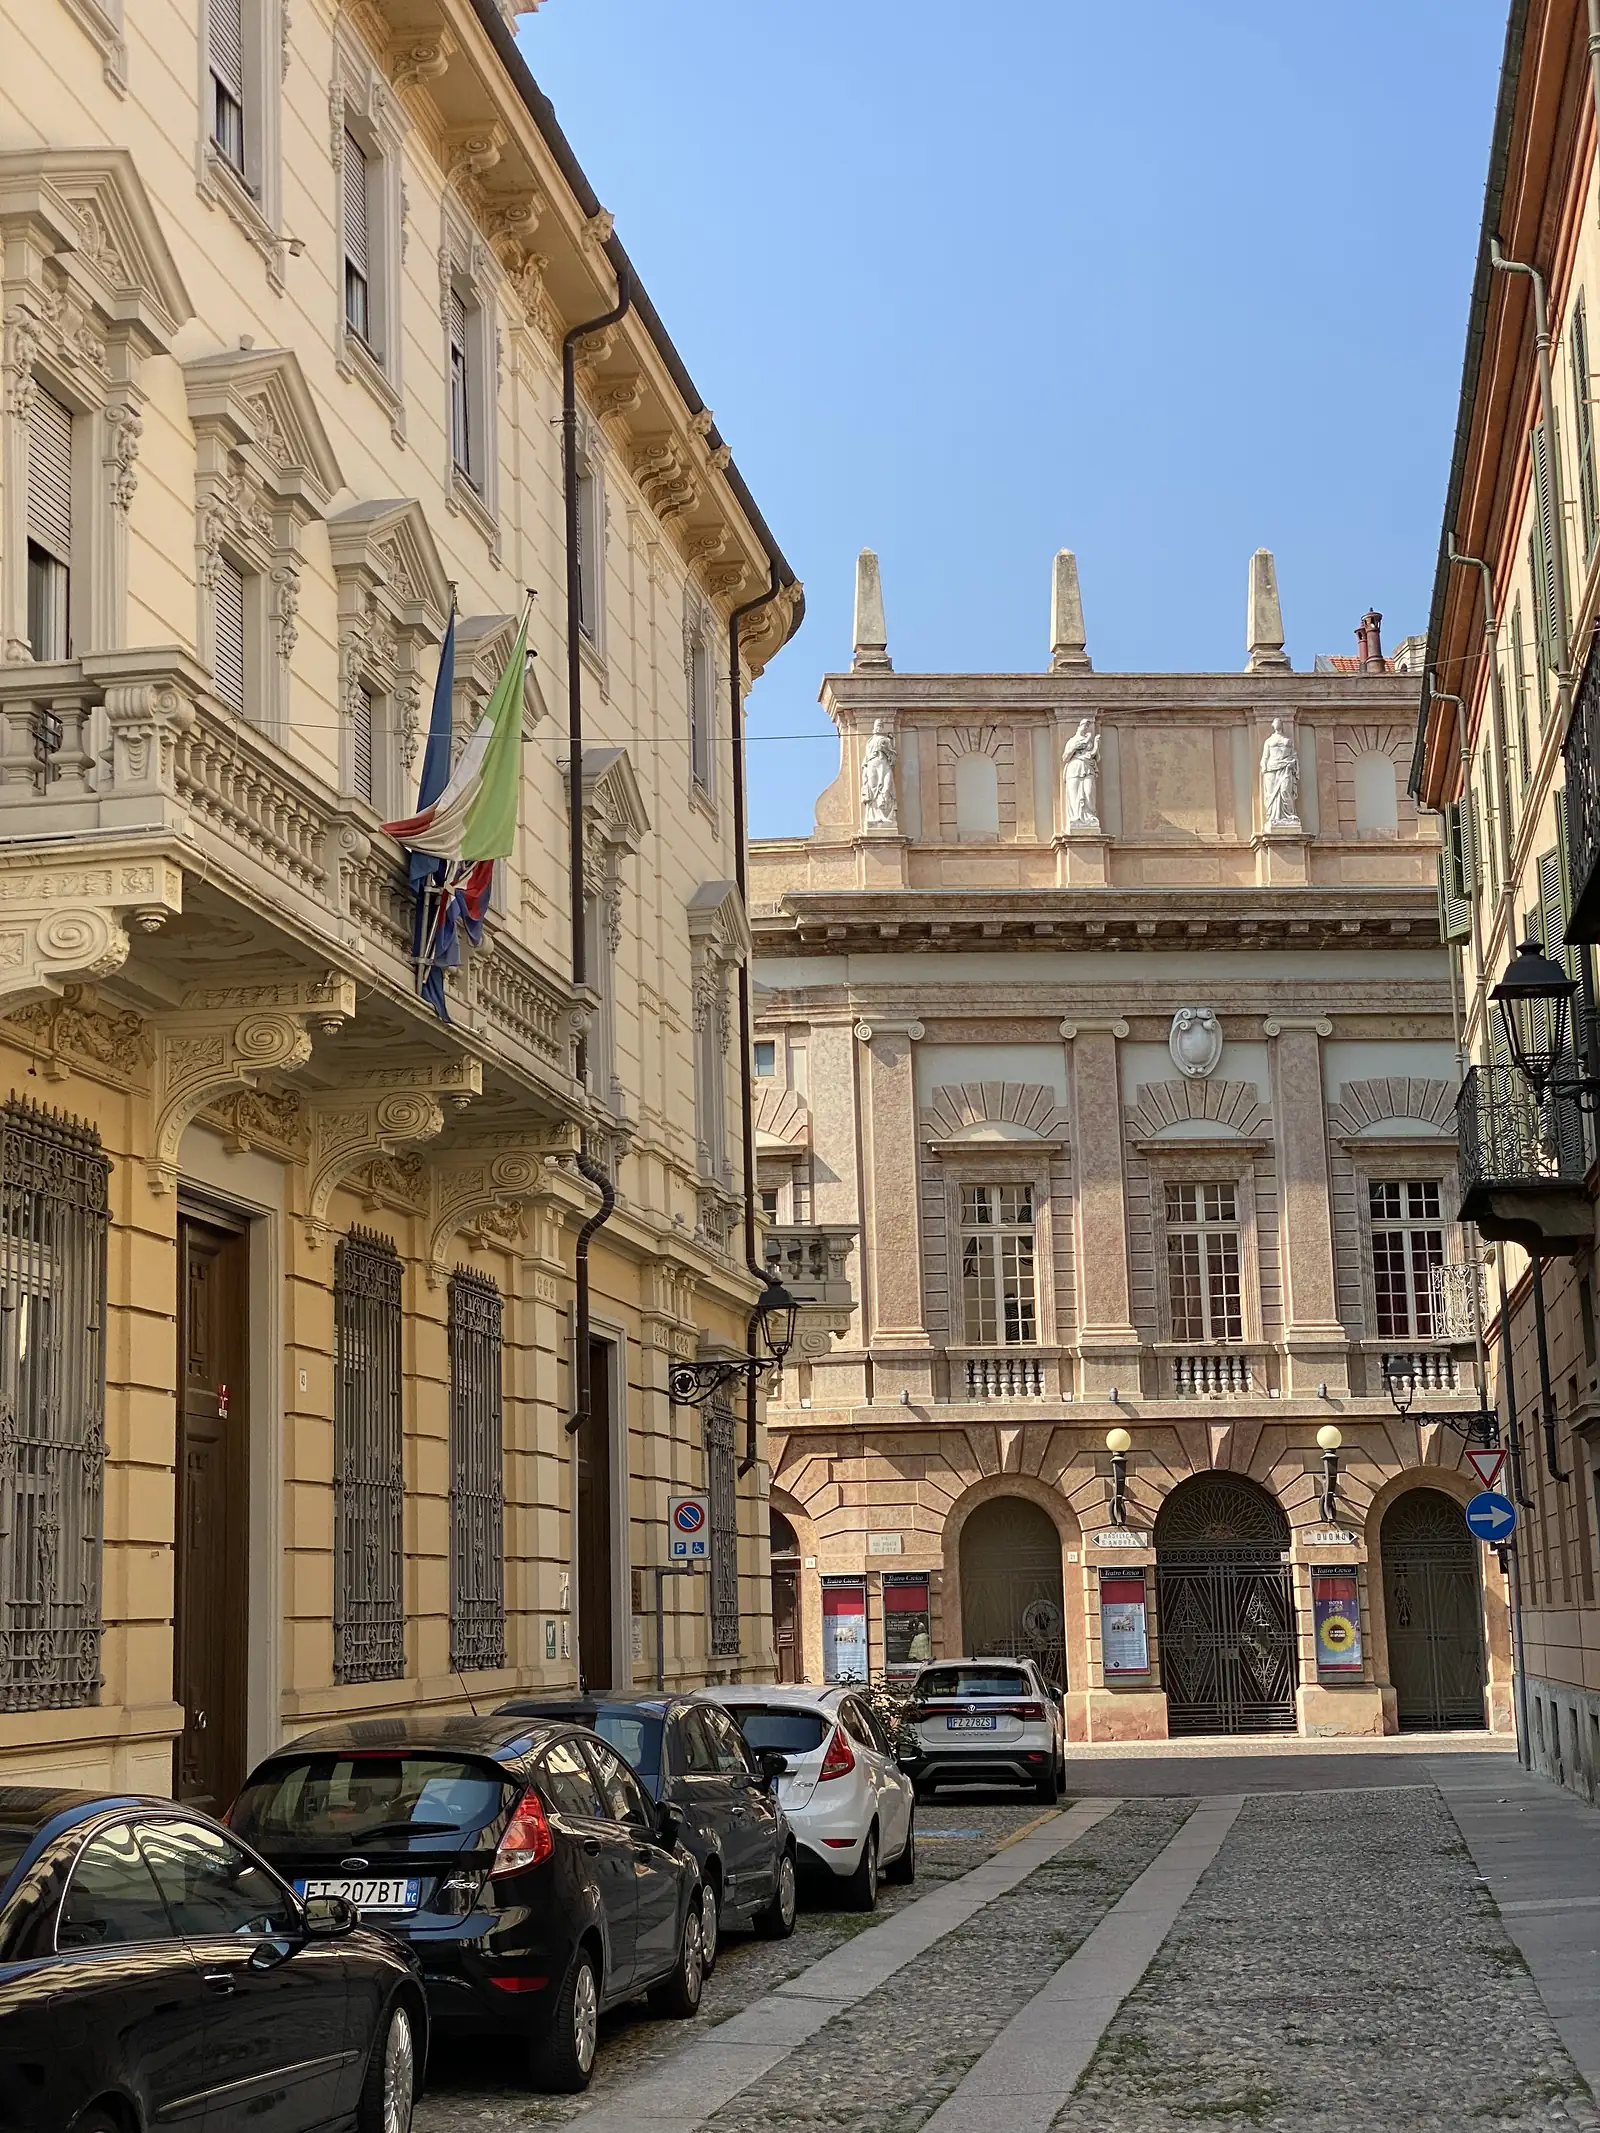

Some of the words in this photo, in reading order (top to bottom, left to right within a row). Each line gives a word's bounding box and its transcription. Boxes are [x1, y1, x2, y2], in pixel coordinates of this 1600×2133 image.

[676, 1543, 685, 1554] P
[953, 1718, 963, 1727] FZ
[340, 1881, 404, 1903] 207BT
